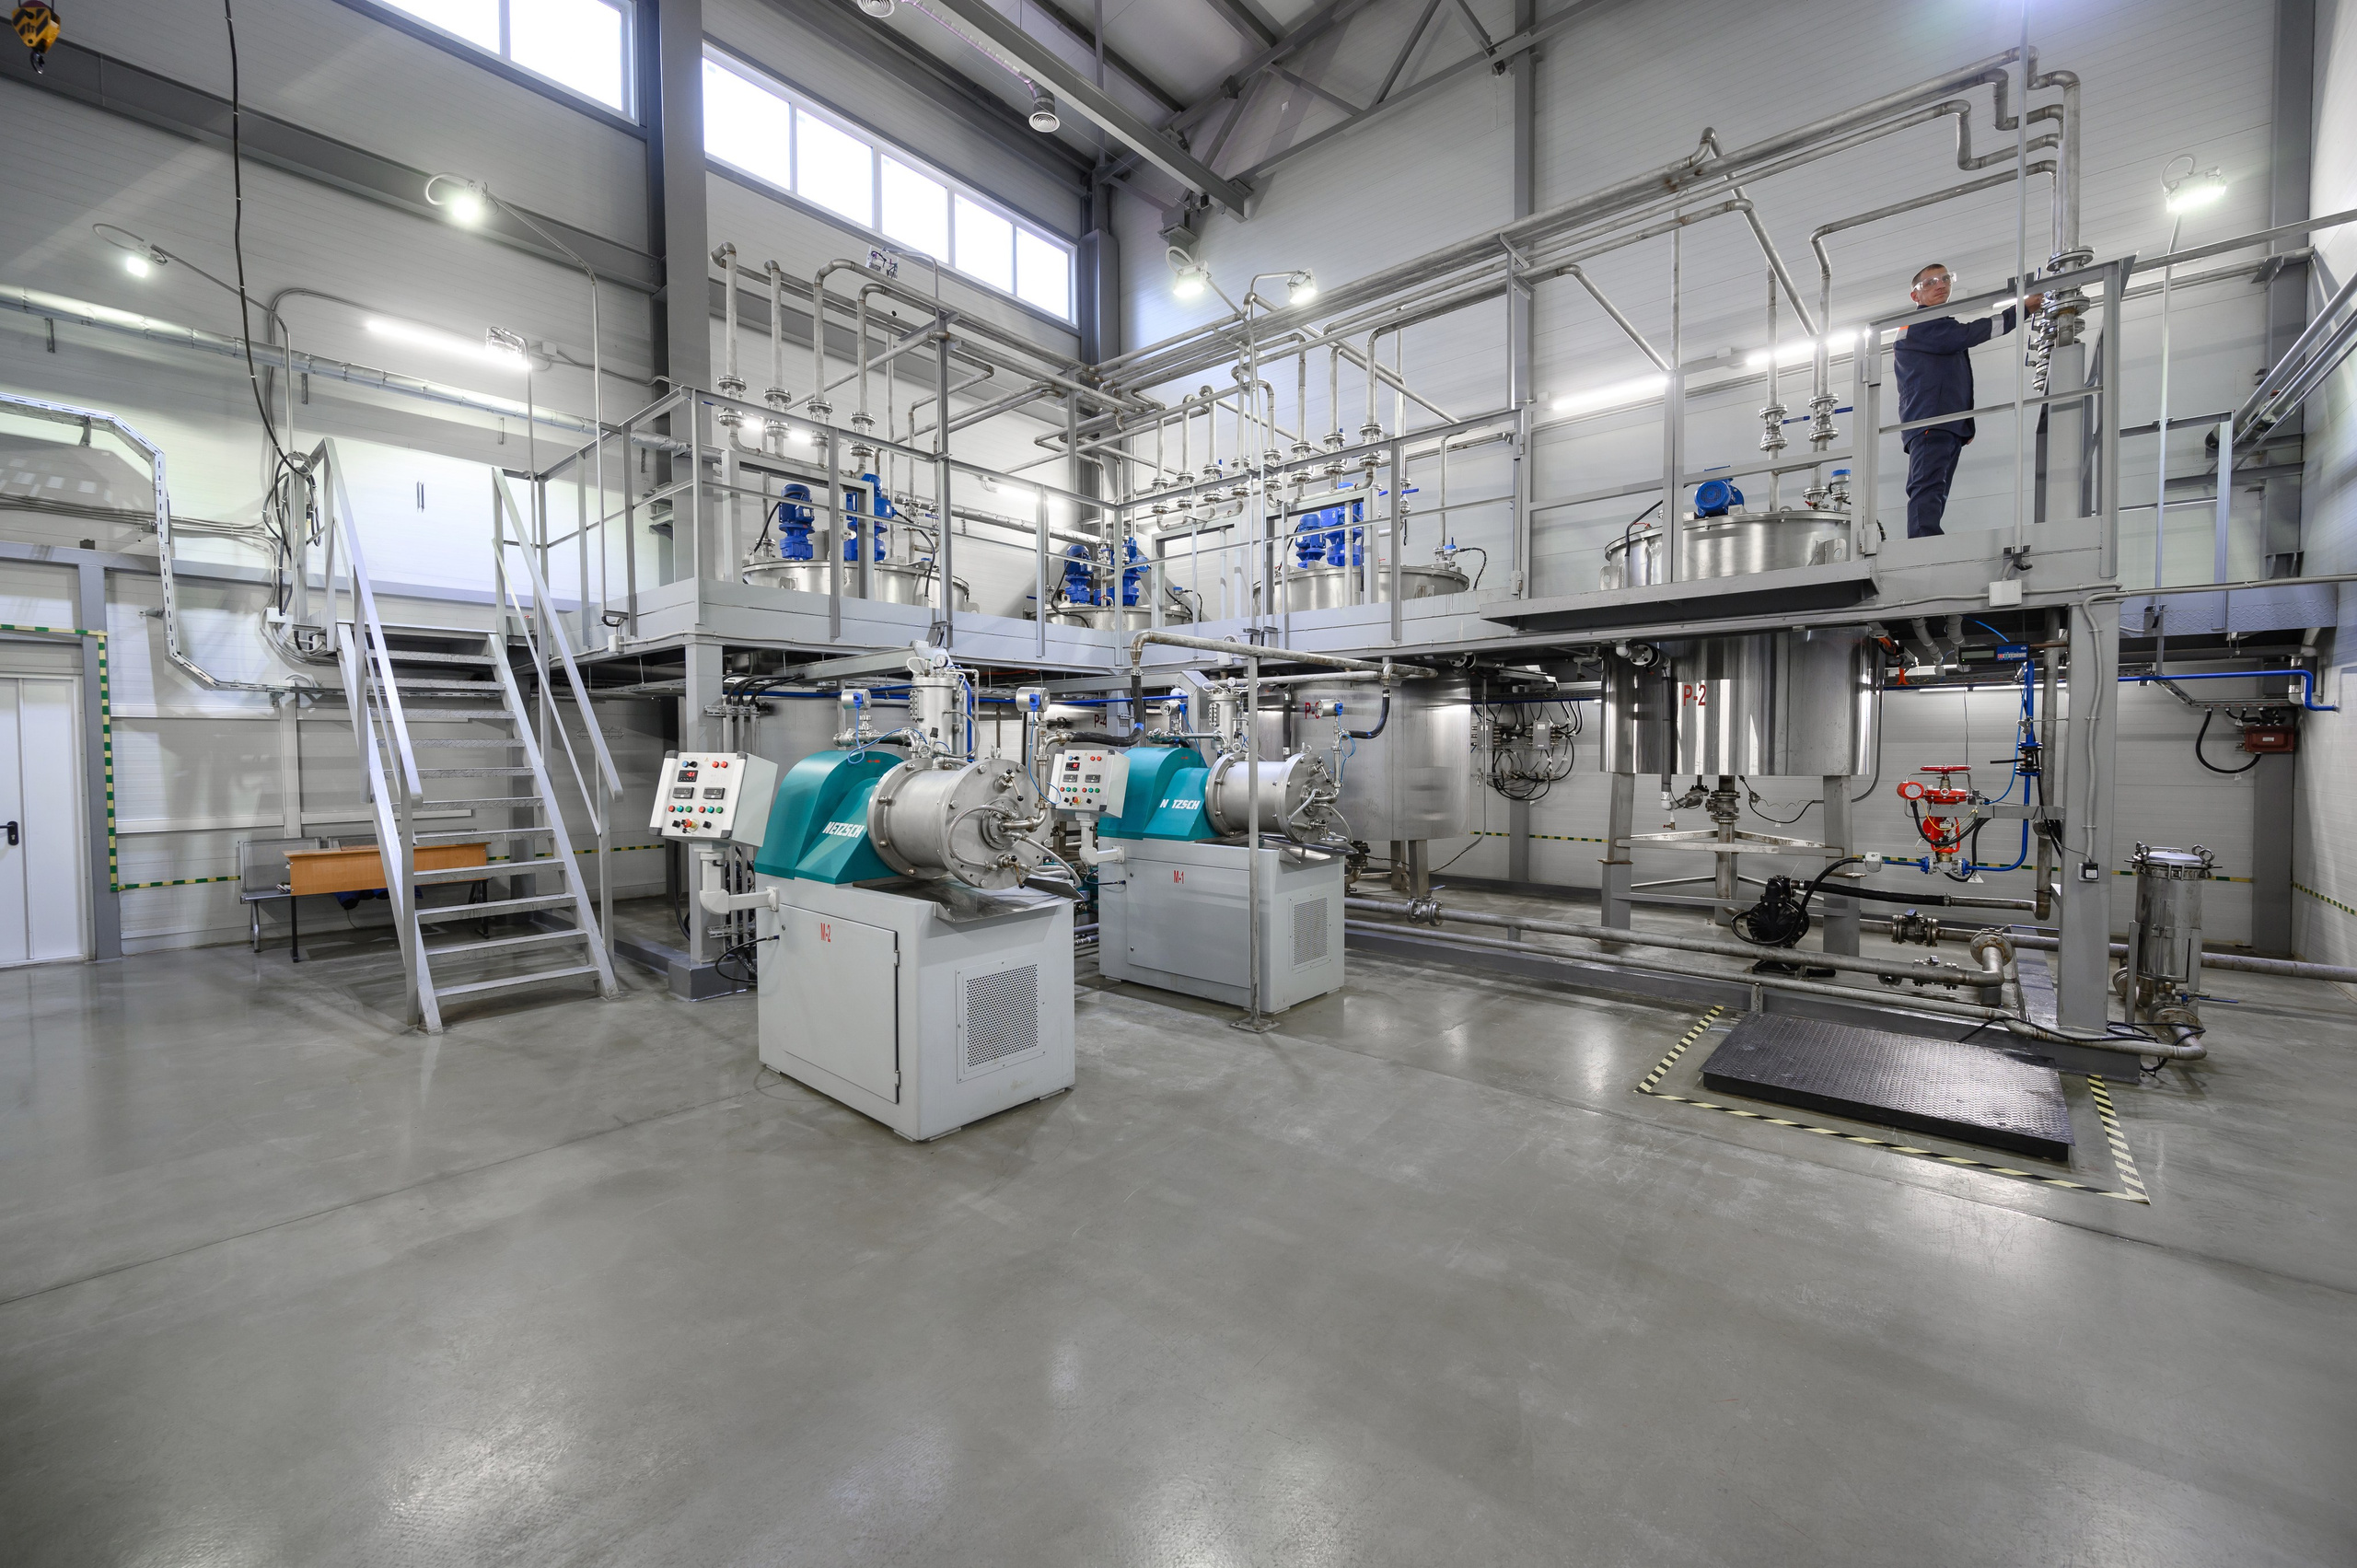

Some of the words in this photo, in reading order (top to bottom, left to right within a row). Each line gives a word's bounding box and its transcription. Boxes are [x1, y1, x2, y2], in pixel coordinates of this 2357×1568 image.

[1683, 684, 1706, 706] P-2
[1094, 714, 1107, 728] P-4
[1159, 798, 1201, 810] NTZSCH
[822, 821, 865, 838] NETZSCH
[1173, 869, 1184, 884] M-1
[820, 922, 830, 943] M-2
